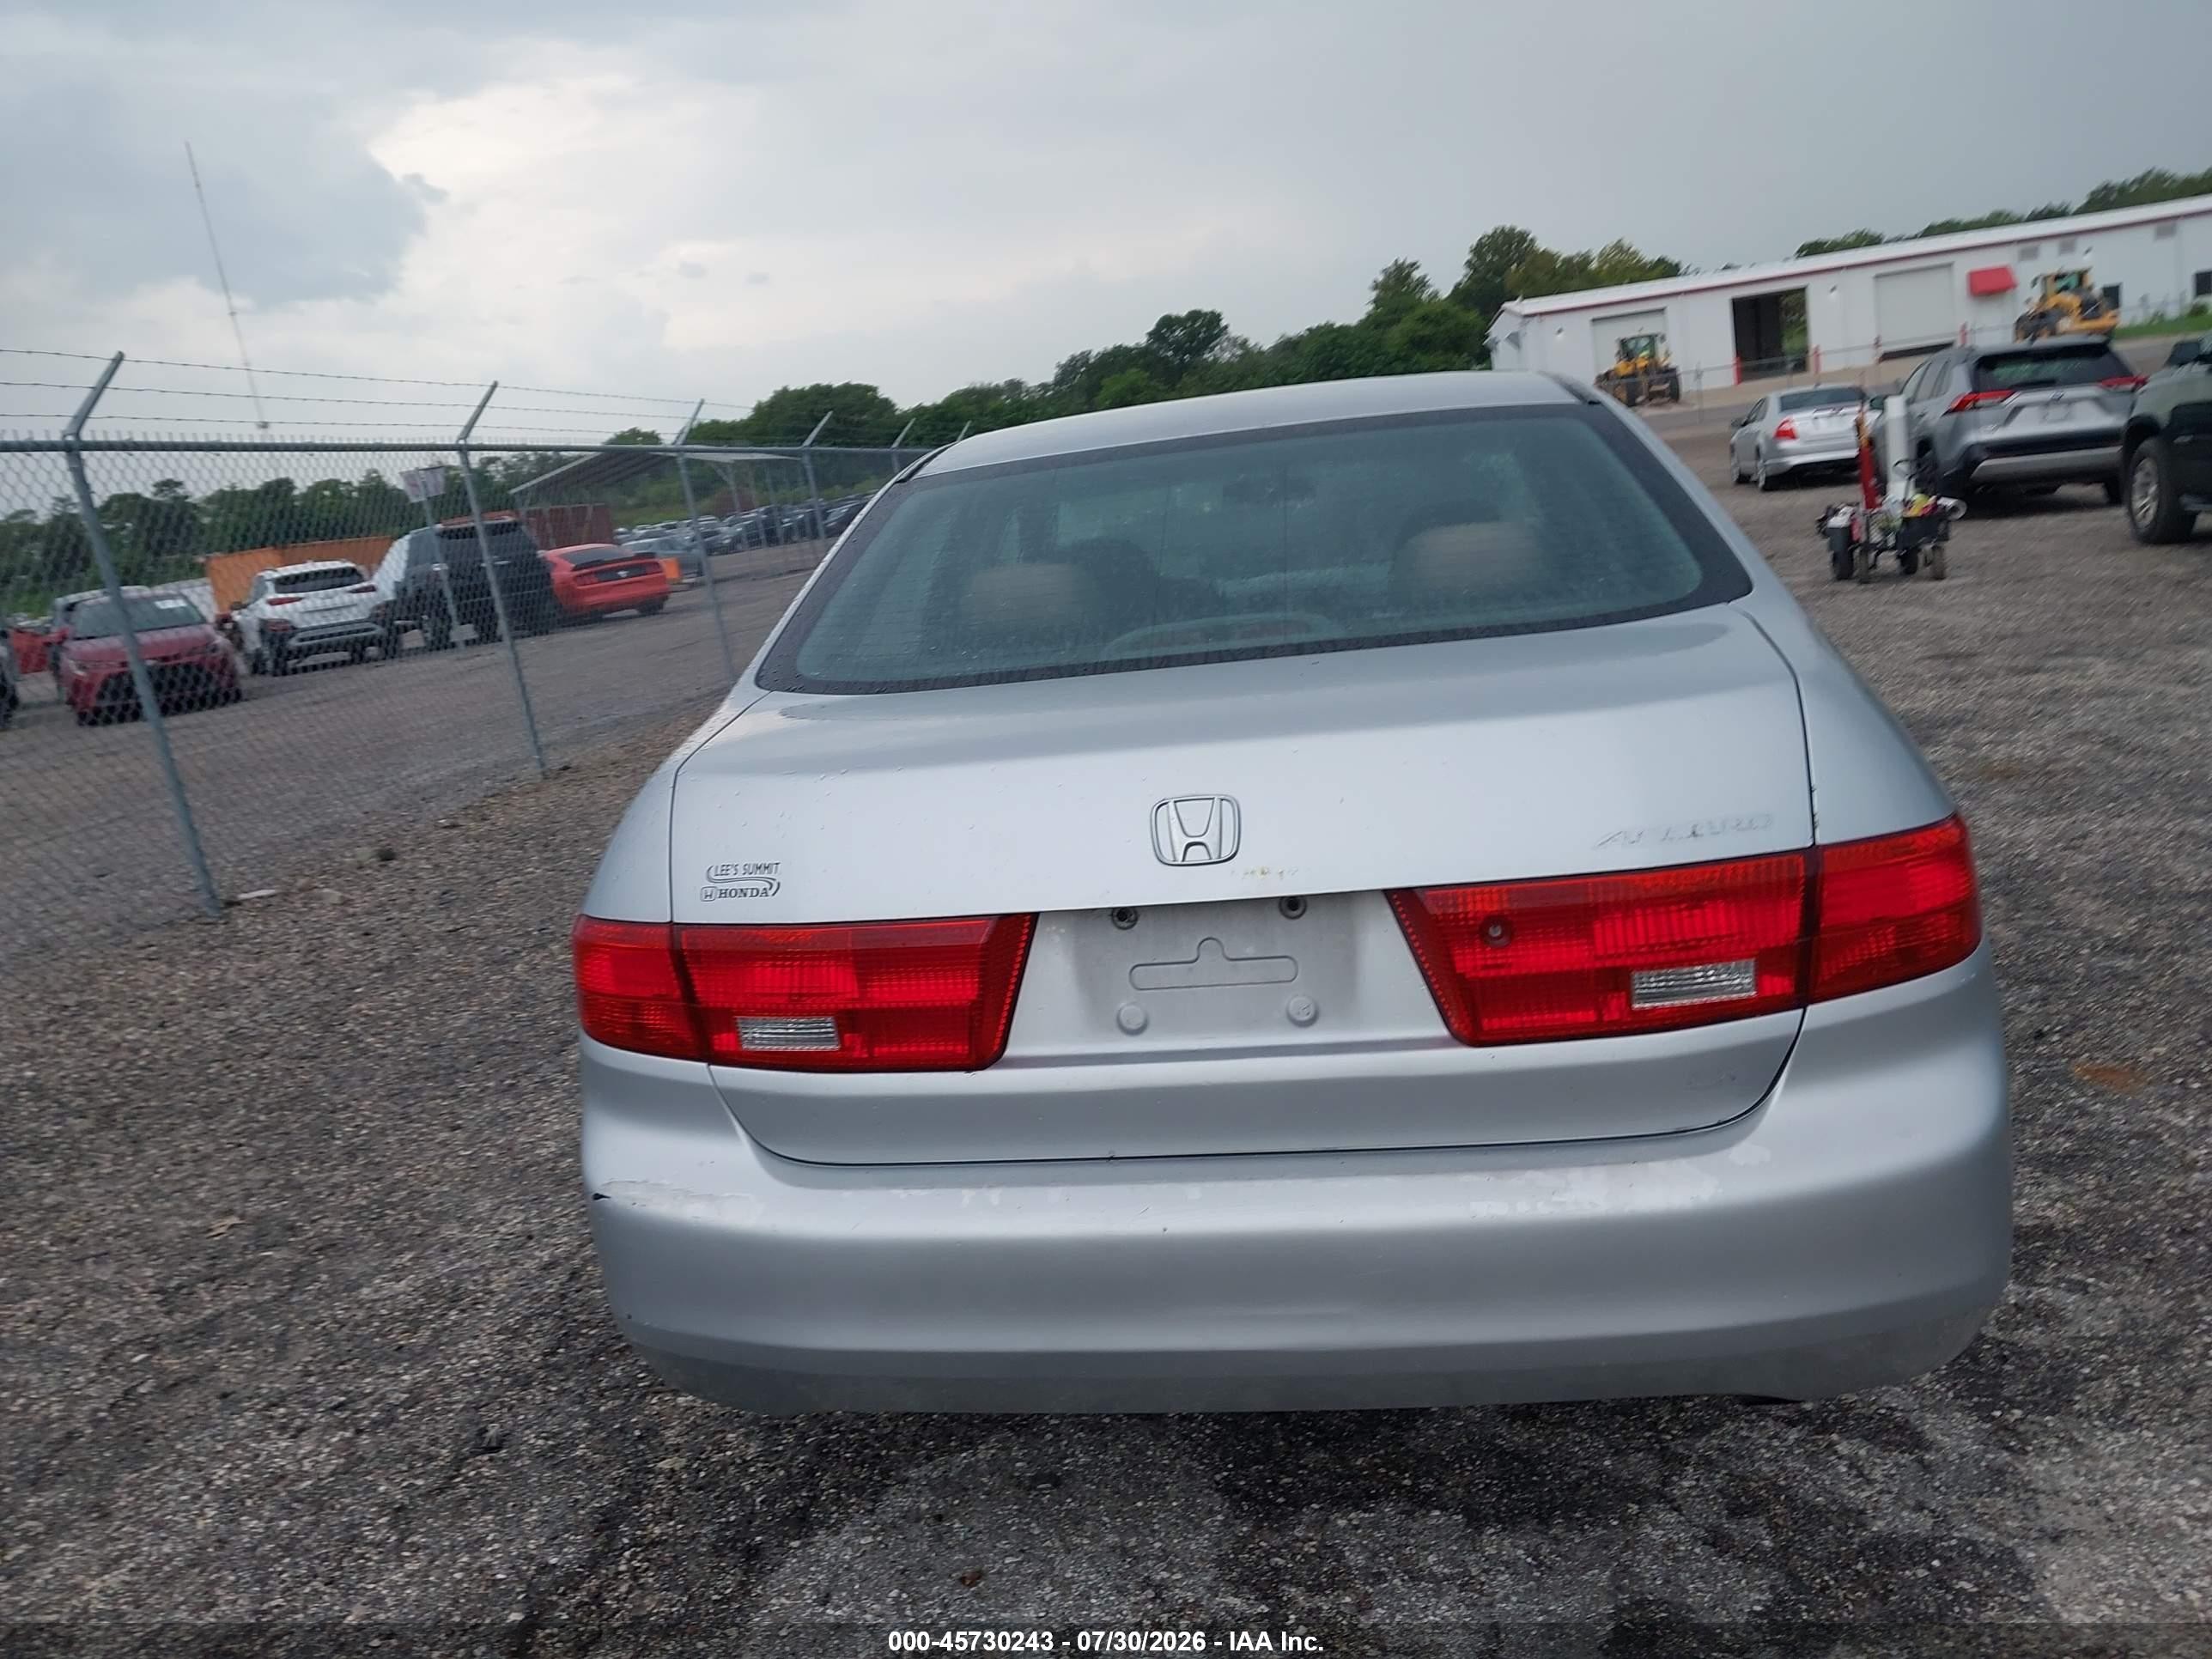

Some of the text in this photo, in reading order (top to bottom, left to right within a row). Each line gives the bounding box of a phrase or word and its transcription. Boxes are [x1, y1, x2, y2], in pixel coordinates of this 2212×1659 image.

[714, 861, 781, 877] LEE'S SUMMIT
[718, 887, 769, 899] HONDA
